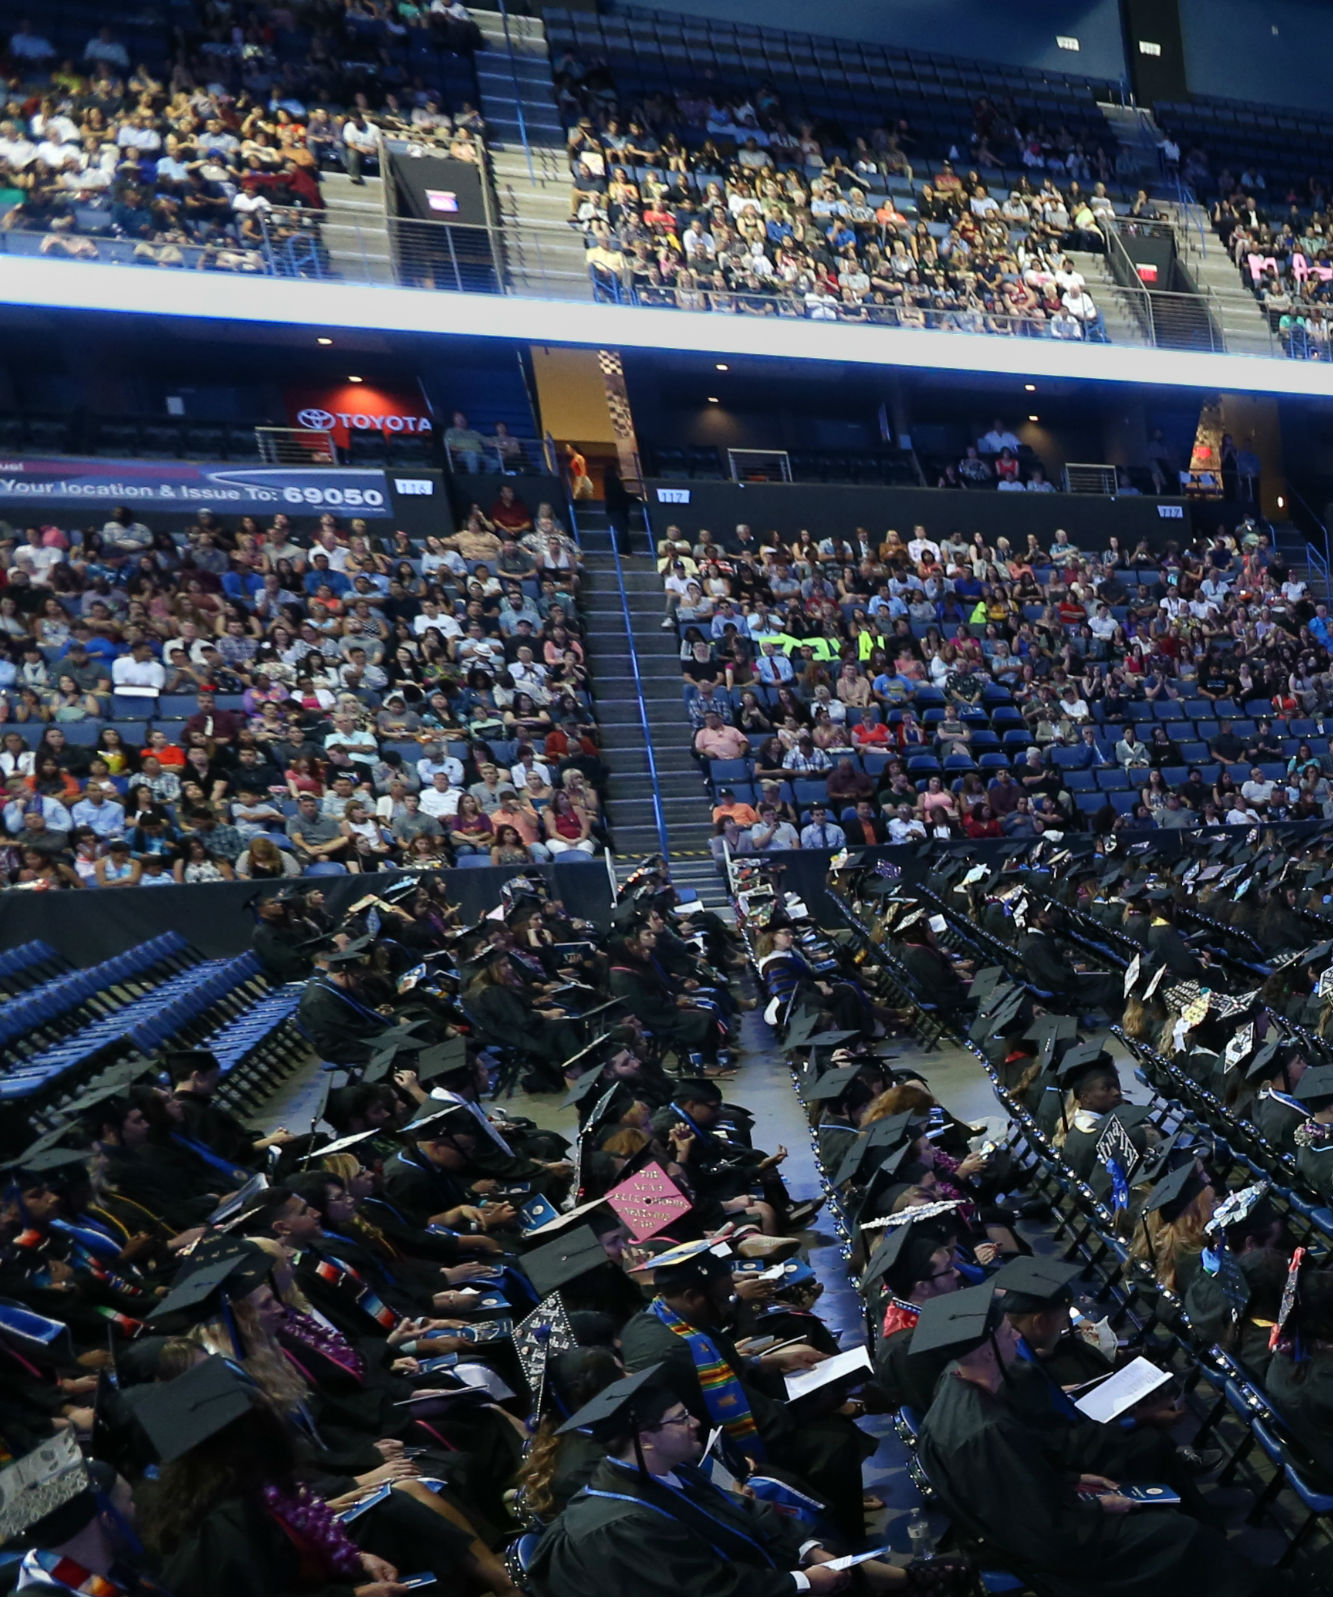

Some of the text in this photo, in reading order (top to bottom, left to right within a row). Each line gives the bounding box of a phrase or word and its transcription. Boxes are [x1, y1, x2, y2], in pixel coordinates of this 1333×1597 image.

[336, 413, 432, 431] TOYOTA
[0, 479, 383, 505] Your location & Issue To: 69050
[662, 492, 683, 503] 117
